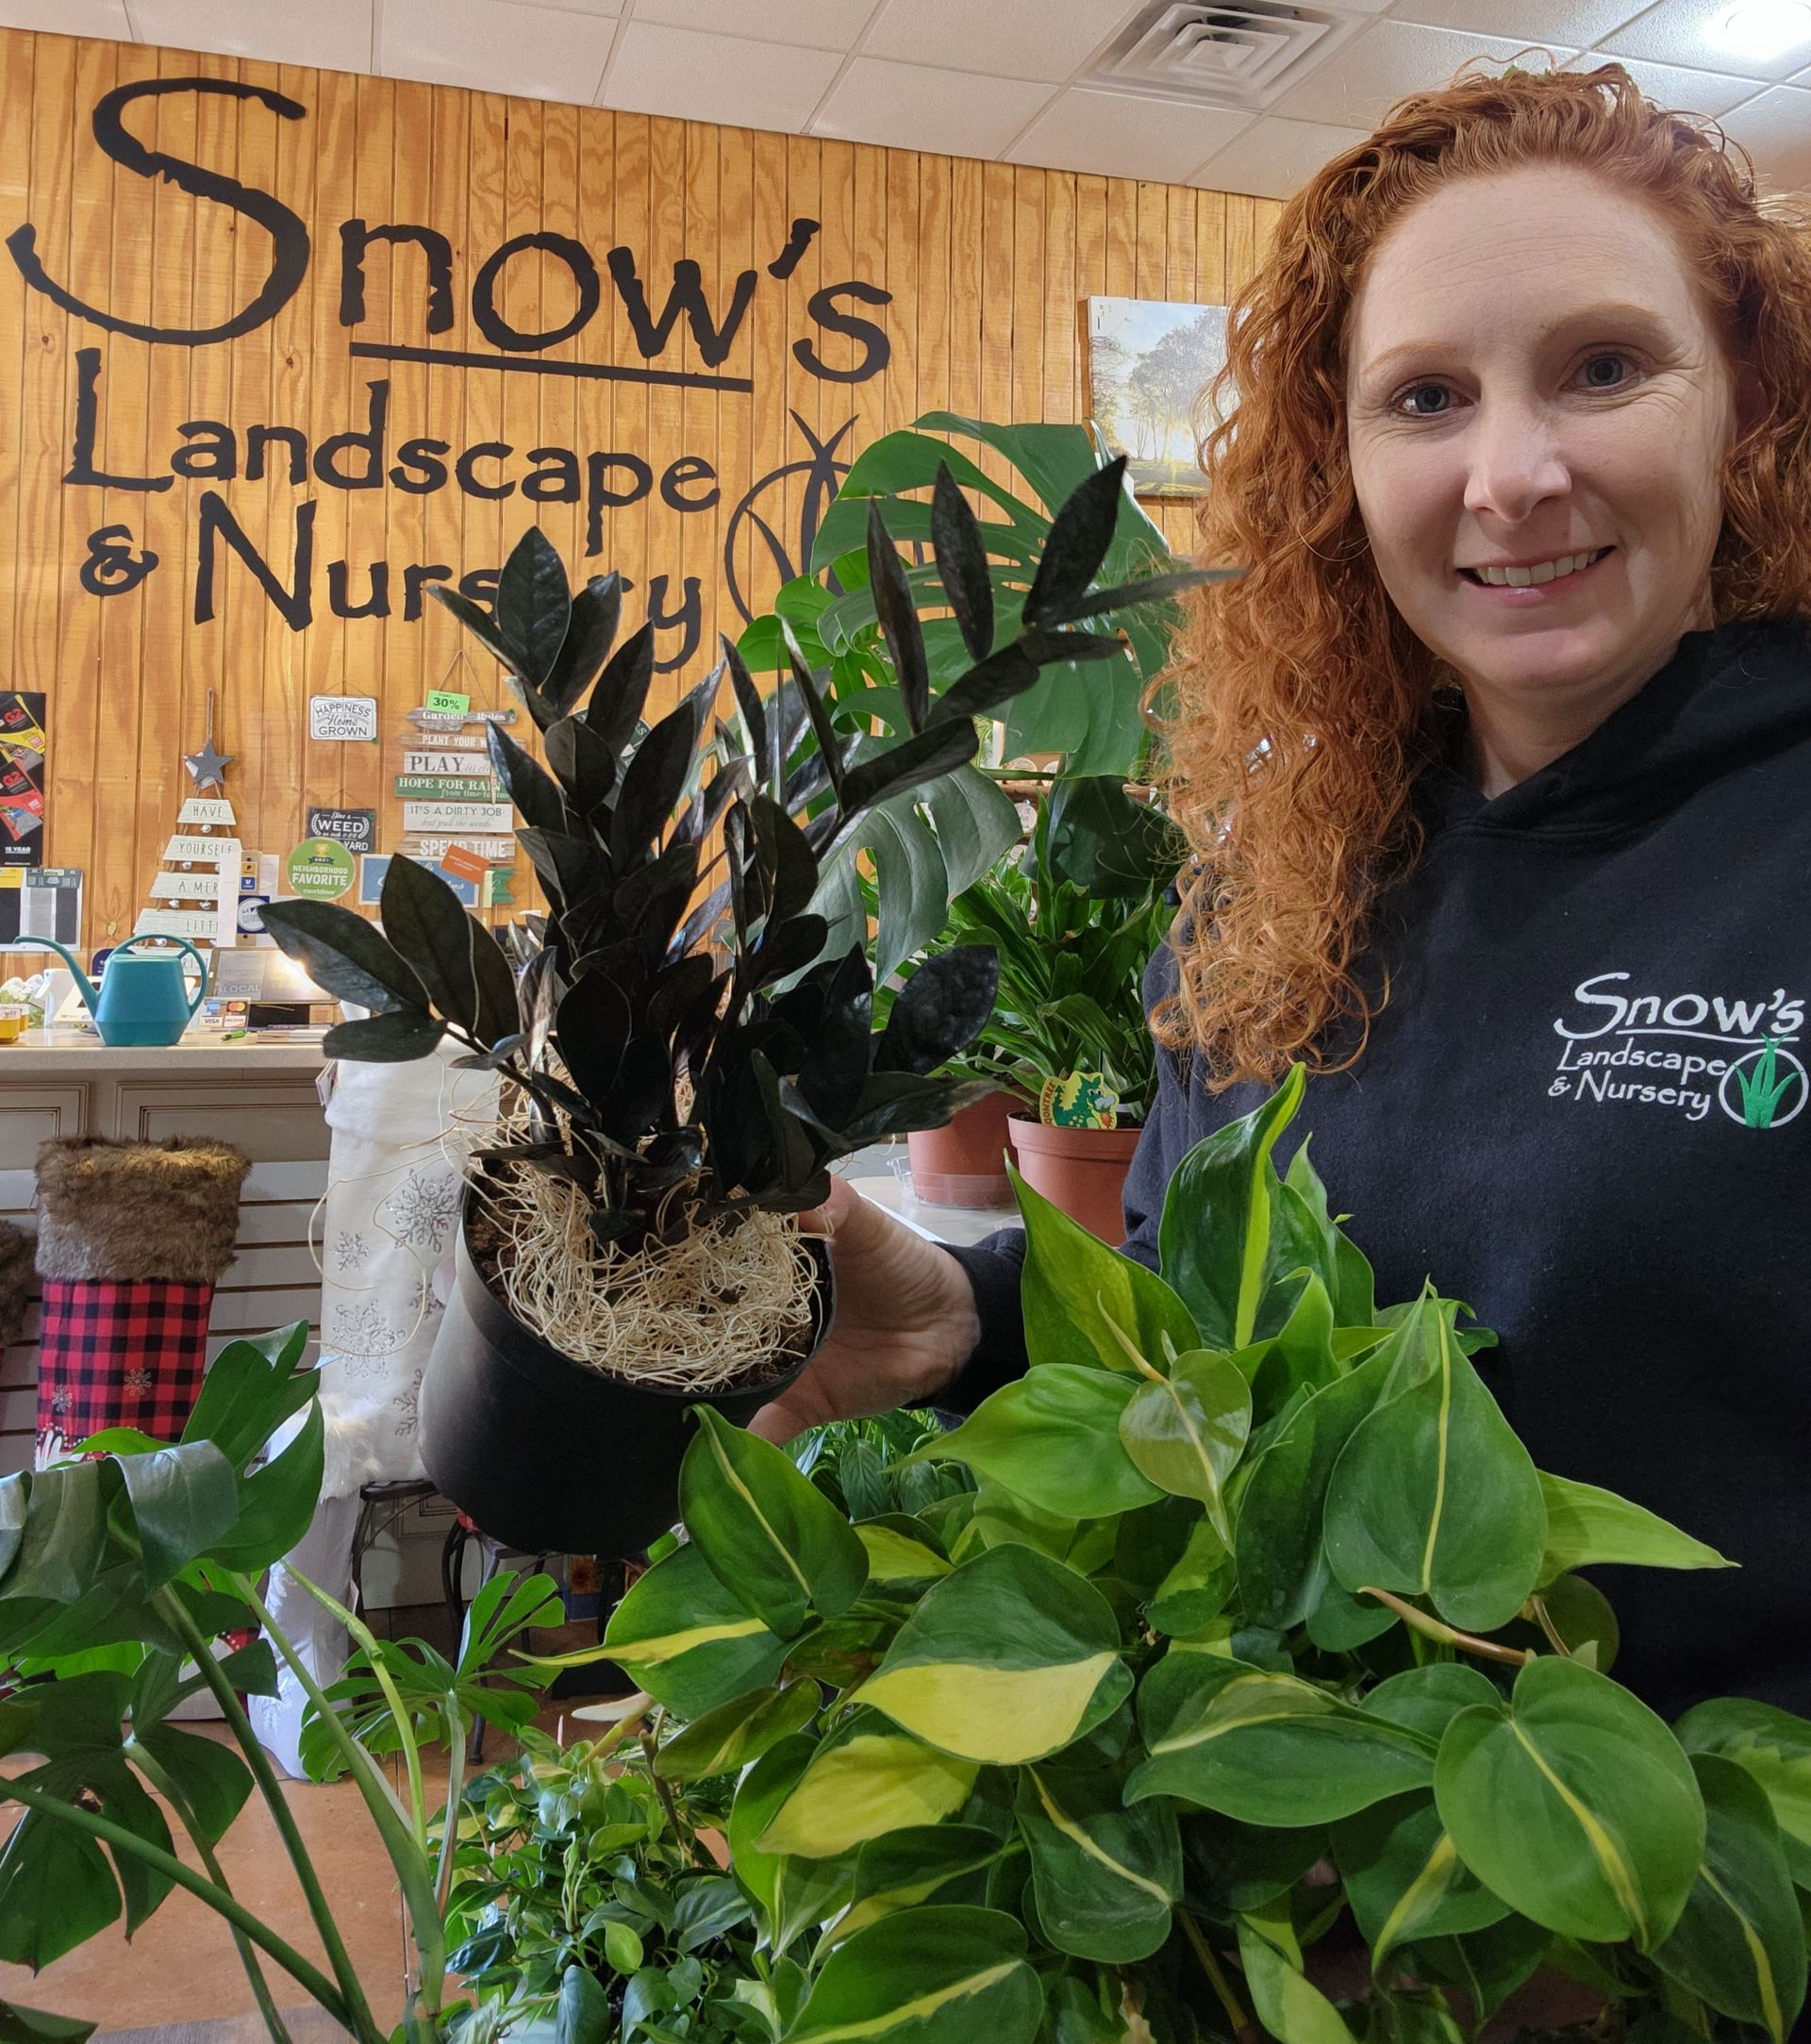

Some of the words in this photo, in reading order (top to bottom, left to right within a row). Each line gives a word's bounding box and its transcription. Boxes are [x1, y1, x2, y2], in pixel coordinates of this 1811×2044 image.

[5, 76, 893, 383] Snow's
[60, 347, 721, 557] Landscape
[79, 524, 159, 596] &
[193, 490, 702, 673] Nursy
[315, 703, 371, 717] HAPPINESS
[433, 697, 460, 710] 30%
[327, 714, 358, 726] Home
[423, 710, 464, 721] Garden
[318, 726, 368, 736] GROWN
[422, 735, 450, 745] PLANT
[454, 736, 475, 747] YOUR
[409, 756, 465, 772] PLAY
[399, 777, 434, 789] HOPE
[438, 779, 464, 789] FOR
[440, 789, 461, 798] from
[192, 806, 223, 818] HAVE
[410, 806, 430, 815] IT'S
[434, 806, 443, 815] A
[445, 806, 477, 816] DIRTY
[317, 819, 363, 833] WEED
[343, 840, 369, 851] YARD
[472, 840, 507, 858] TIME
[292, 864, 348, 874] NEIGHBORHOOD
[292, 872, 347, 886] FAVORITE
[178, 881, 186, 892] A
[193, 881, 218, 893] MER
[186, 920, 218, 933] LITT
[224, 984, 259, 993] LOCAL
[1553, 972, 1806, 1039] Snow's
[1556, 1038, 1727, 1085] Landscape
[1547, 1076, 1571, 1097] &
[1574, 1070, 1711, 1121] Nursery
